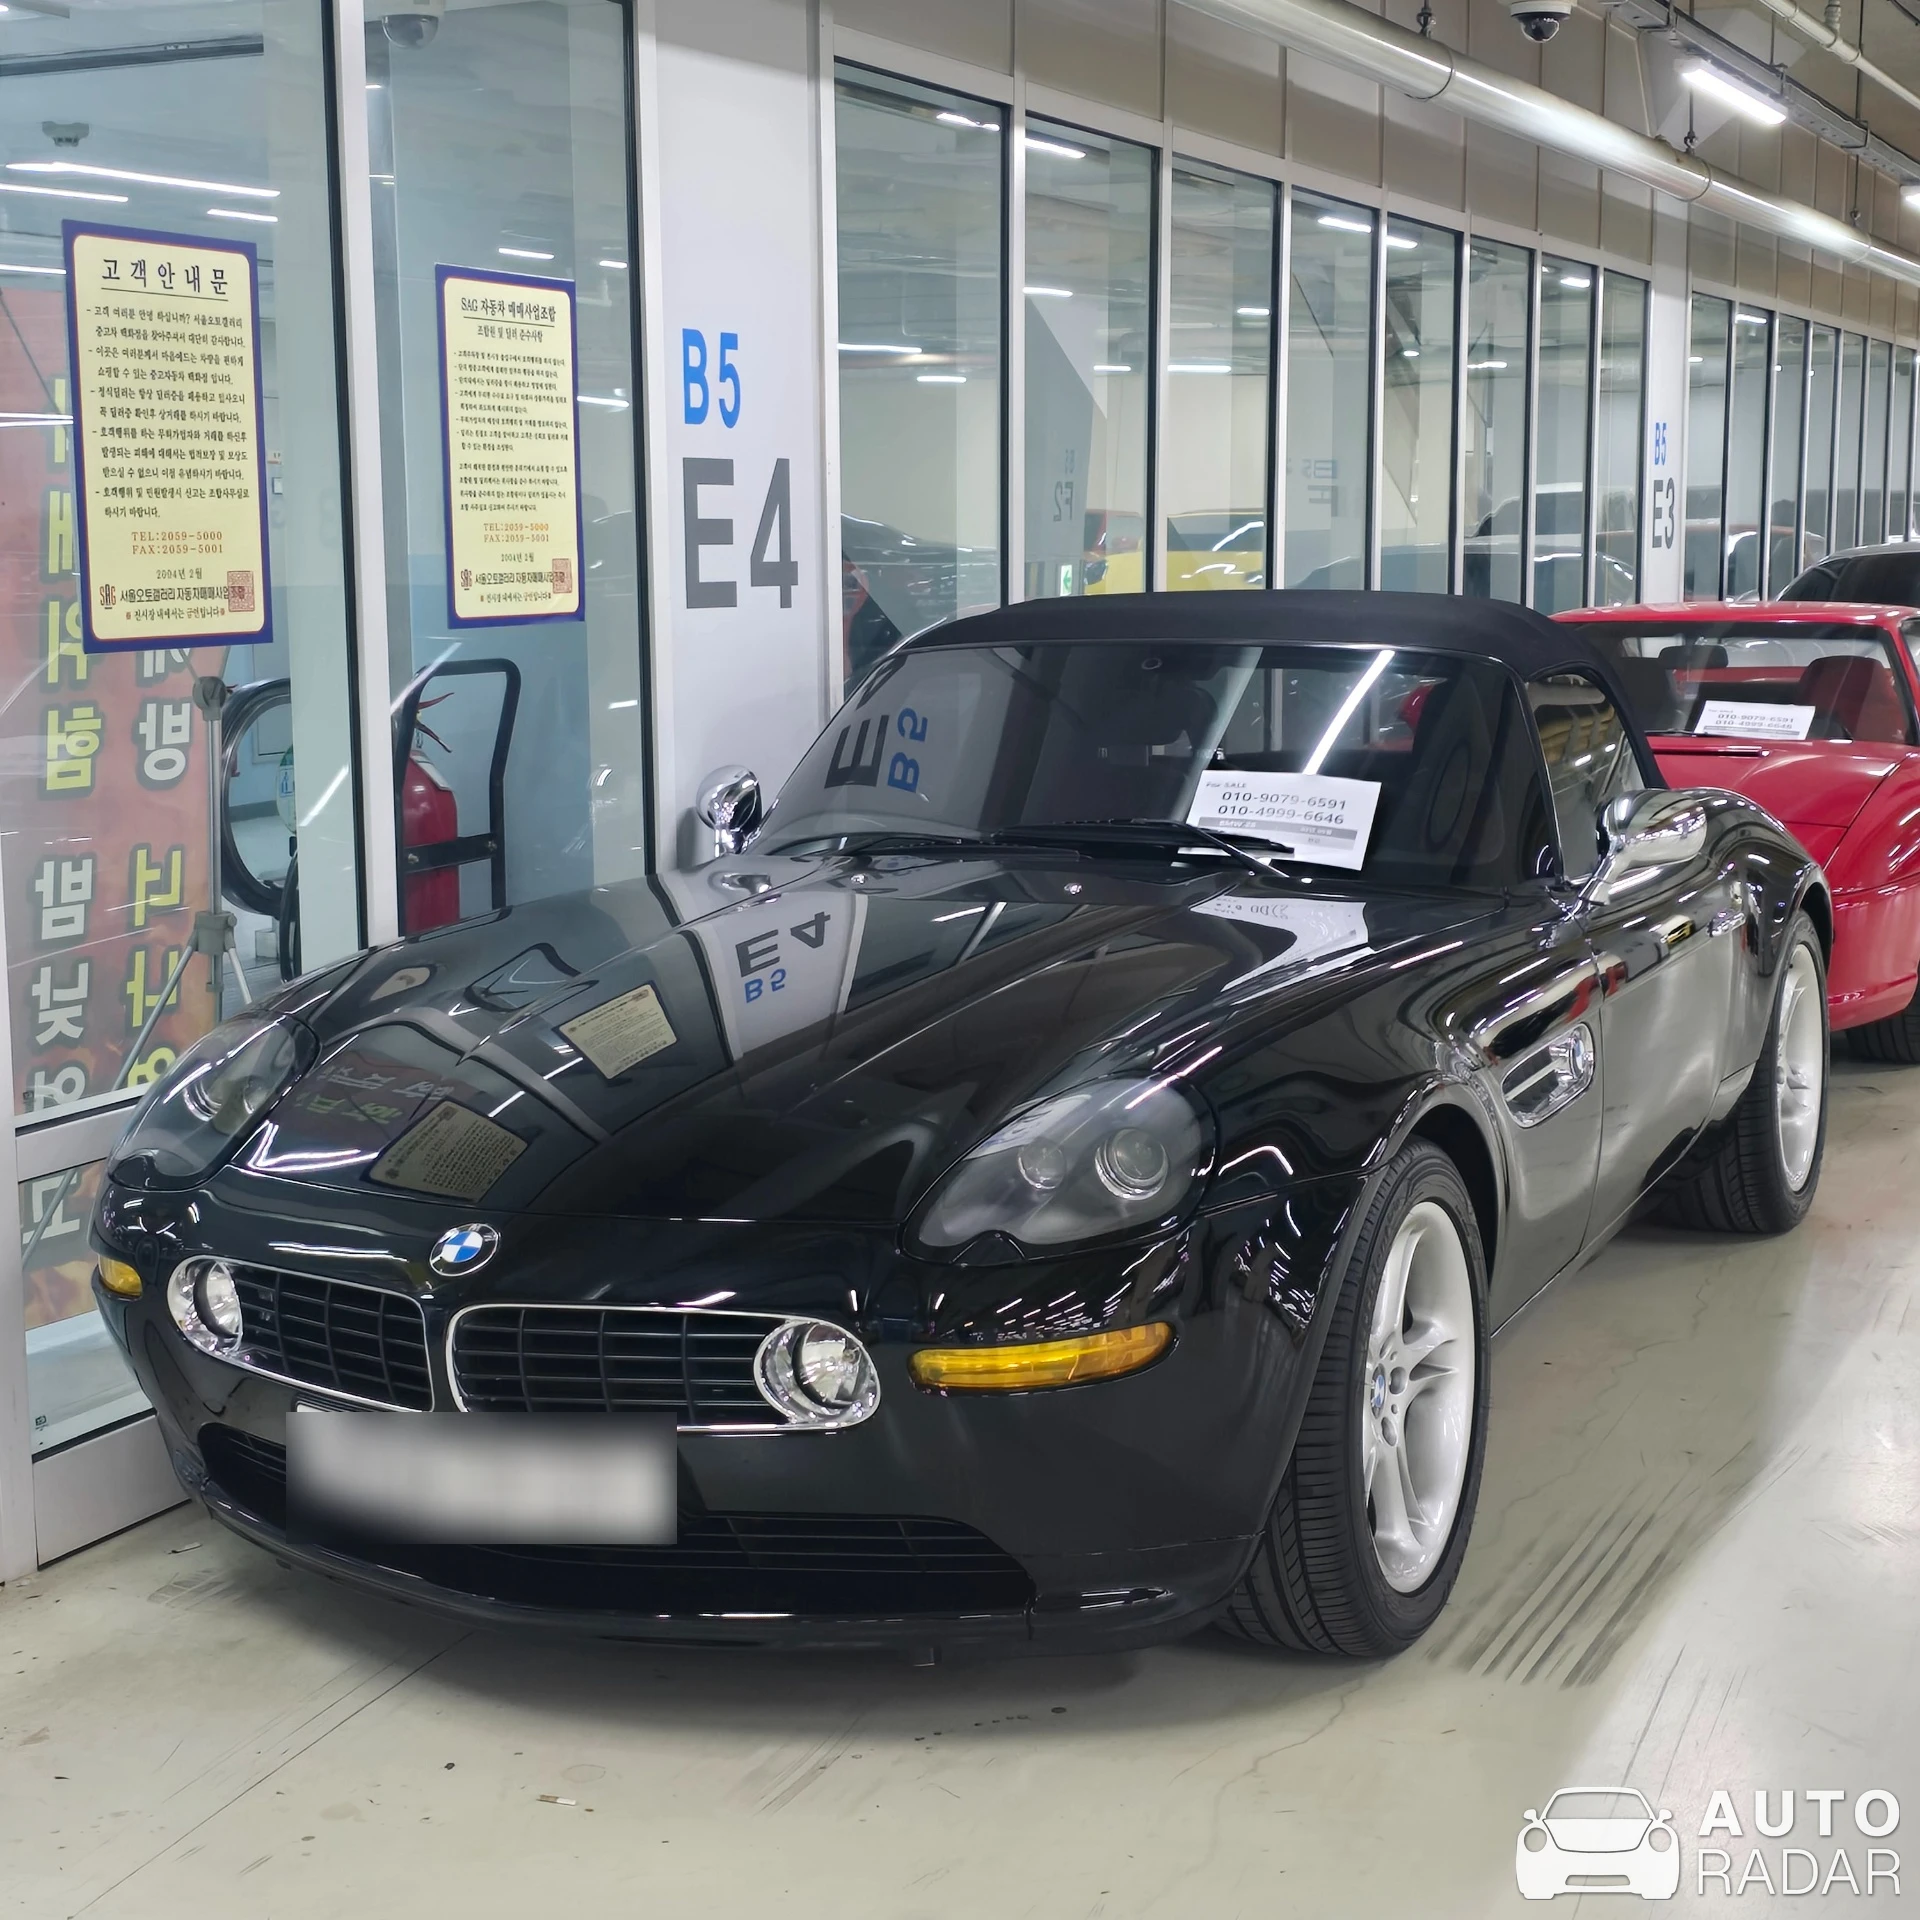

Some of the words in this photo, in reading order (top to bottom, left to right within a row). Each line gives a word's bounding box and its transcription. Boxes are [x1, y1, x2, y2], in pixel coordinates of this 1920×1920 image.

[101, 258, 228, 295] 고객안내문
[460, 297, 478, 312] SAG
[480, 297, 505, 317] 자동차
[507, 300, 556, 322] 매매사업조합
[682, 328, 741, 429] B5
[1654, 422, 1667, 466] B5
[1652, 477, 1675, 550] E3
[130, 530, 222, 541] TEL:2059-5000
[682, 457, 799, 609] E4
[132, 542, 222, 554] FAX:2059-5001
[156, 568, 186, 580] 2004년
[100, 584, 116, 606] SAG
[1221, 791, 1347, 811] 010-9079-6591
[1218, 804, 1344, 825] 010-4999-6646
